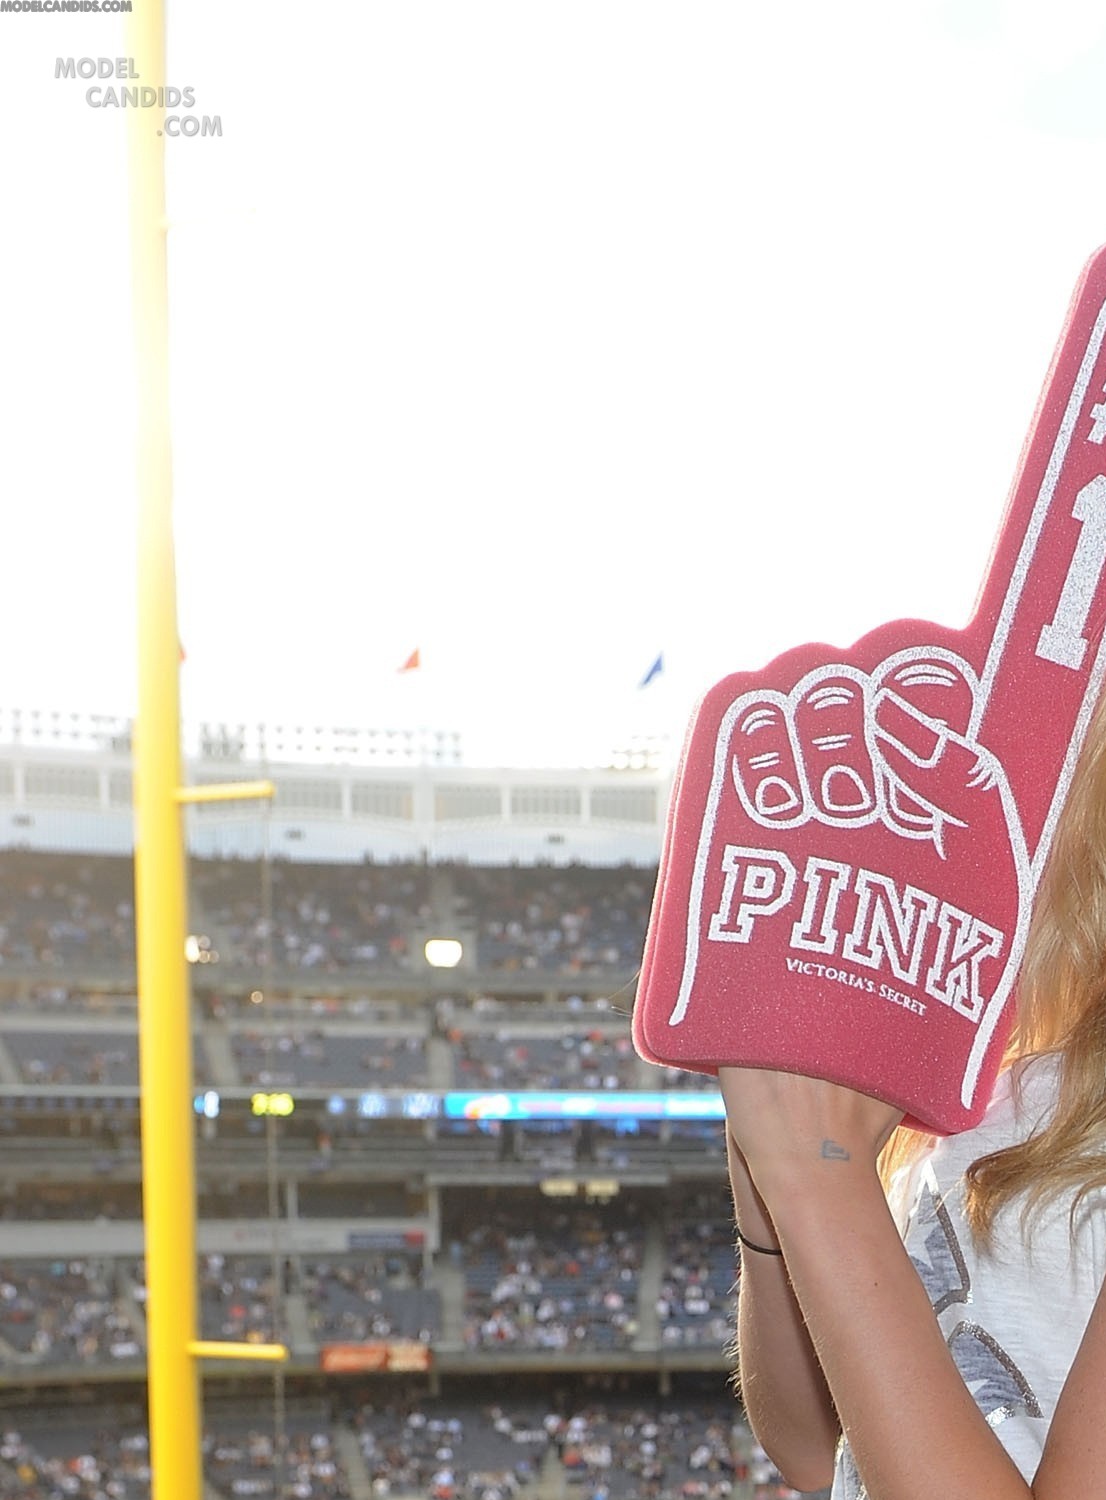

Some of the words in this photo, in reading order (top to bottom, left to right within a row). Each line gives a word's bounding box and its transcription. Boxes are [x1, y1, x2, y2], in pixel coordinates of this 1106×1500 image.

[708, 844, 1004, 1024] PINK
[785, 957, 875, 993] VICTORIA'S
[878, 984, 928, 1017] SECRET
